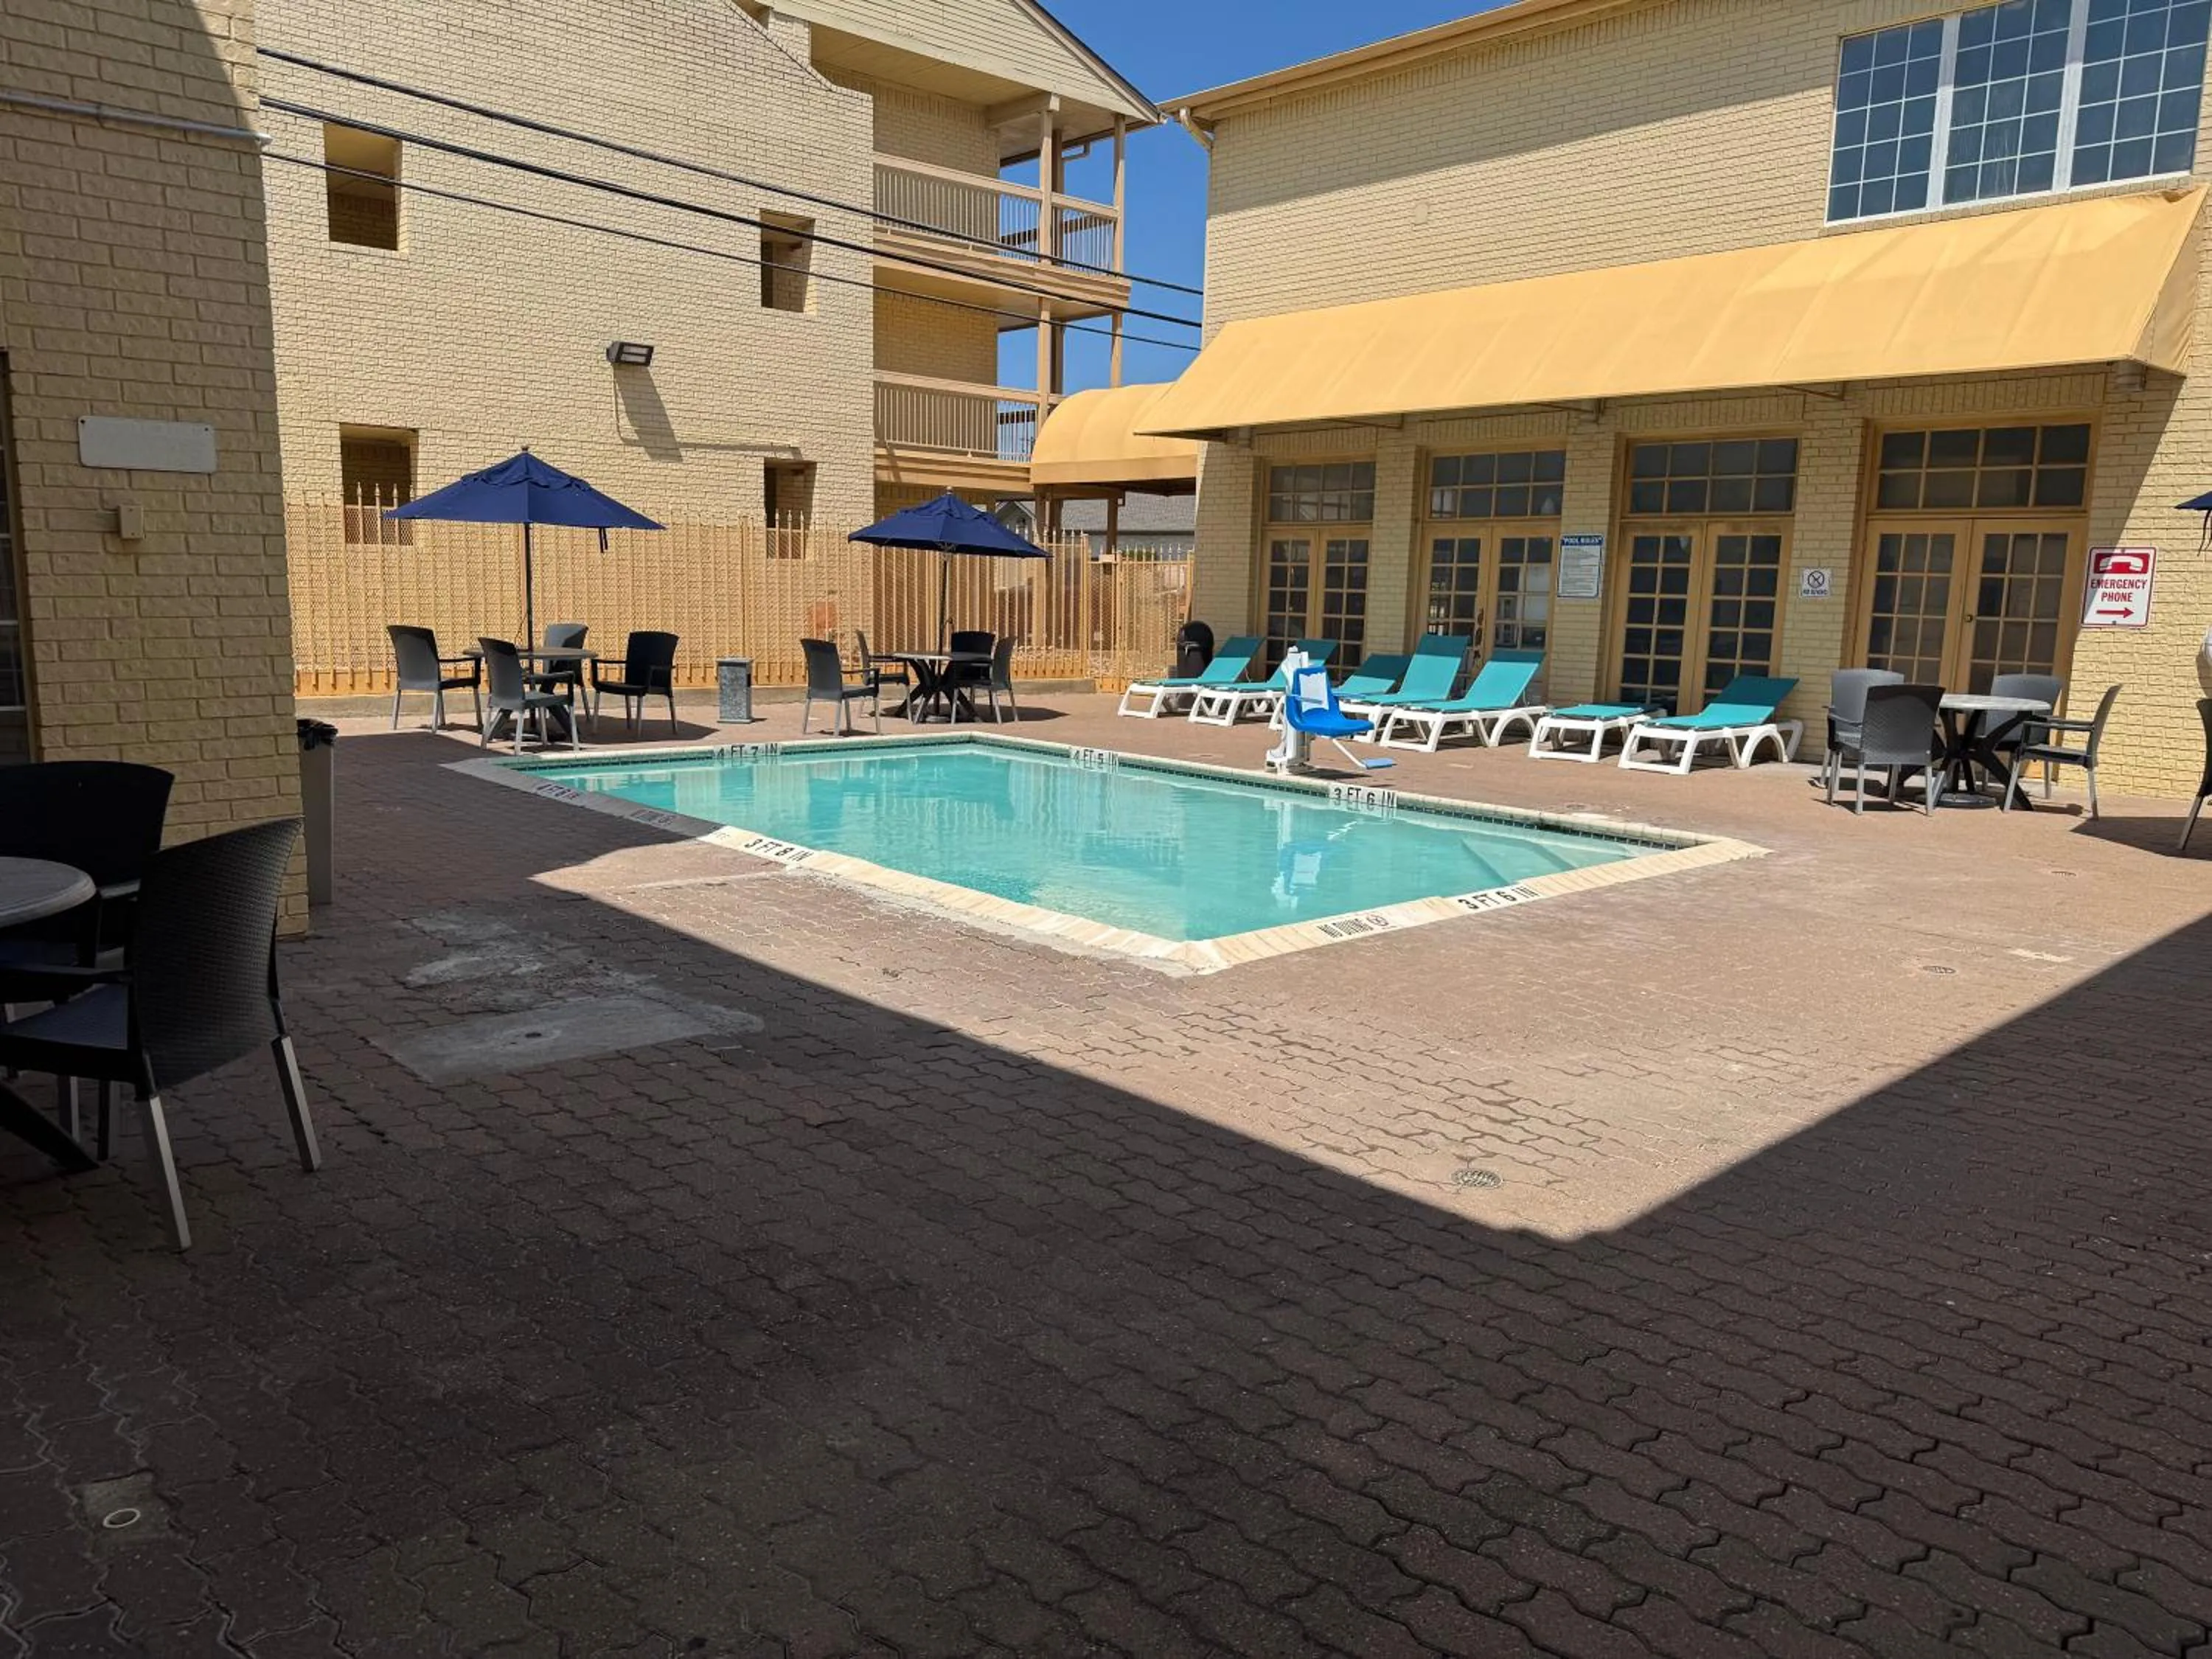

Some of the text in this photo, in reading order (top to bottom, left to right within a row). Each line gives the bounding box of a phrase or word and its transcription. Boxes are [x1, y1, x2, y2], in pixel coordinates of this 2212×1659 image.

[2090, 579, 2148, 589] EMERGENCY
[2101, 592, 2134, 602] PHONE
[731, 744, 745, 758] FT
[765, 742, 778, 754] IN
[1083, 748, 1094, 762] FT
[1334, 787, 1396, 807] 3 FT 6 IN
[744, 839, 763, 848] 3
[754, 841, 783, 853] FT
[1458, 899, 1479, 909] 3
[1472, 893, 1500, 907] FT
[1495, 891, 1517, 902] 6
